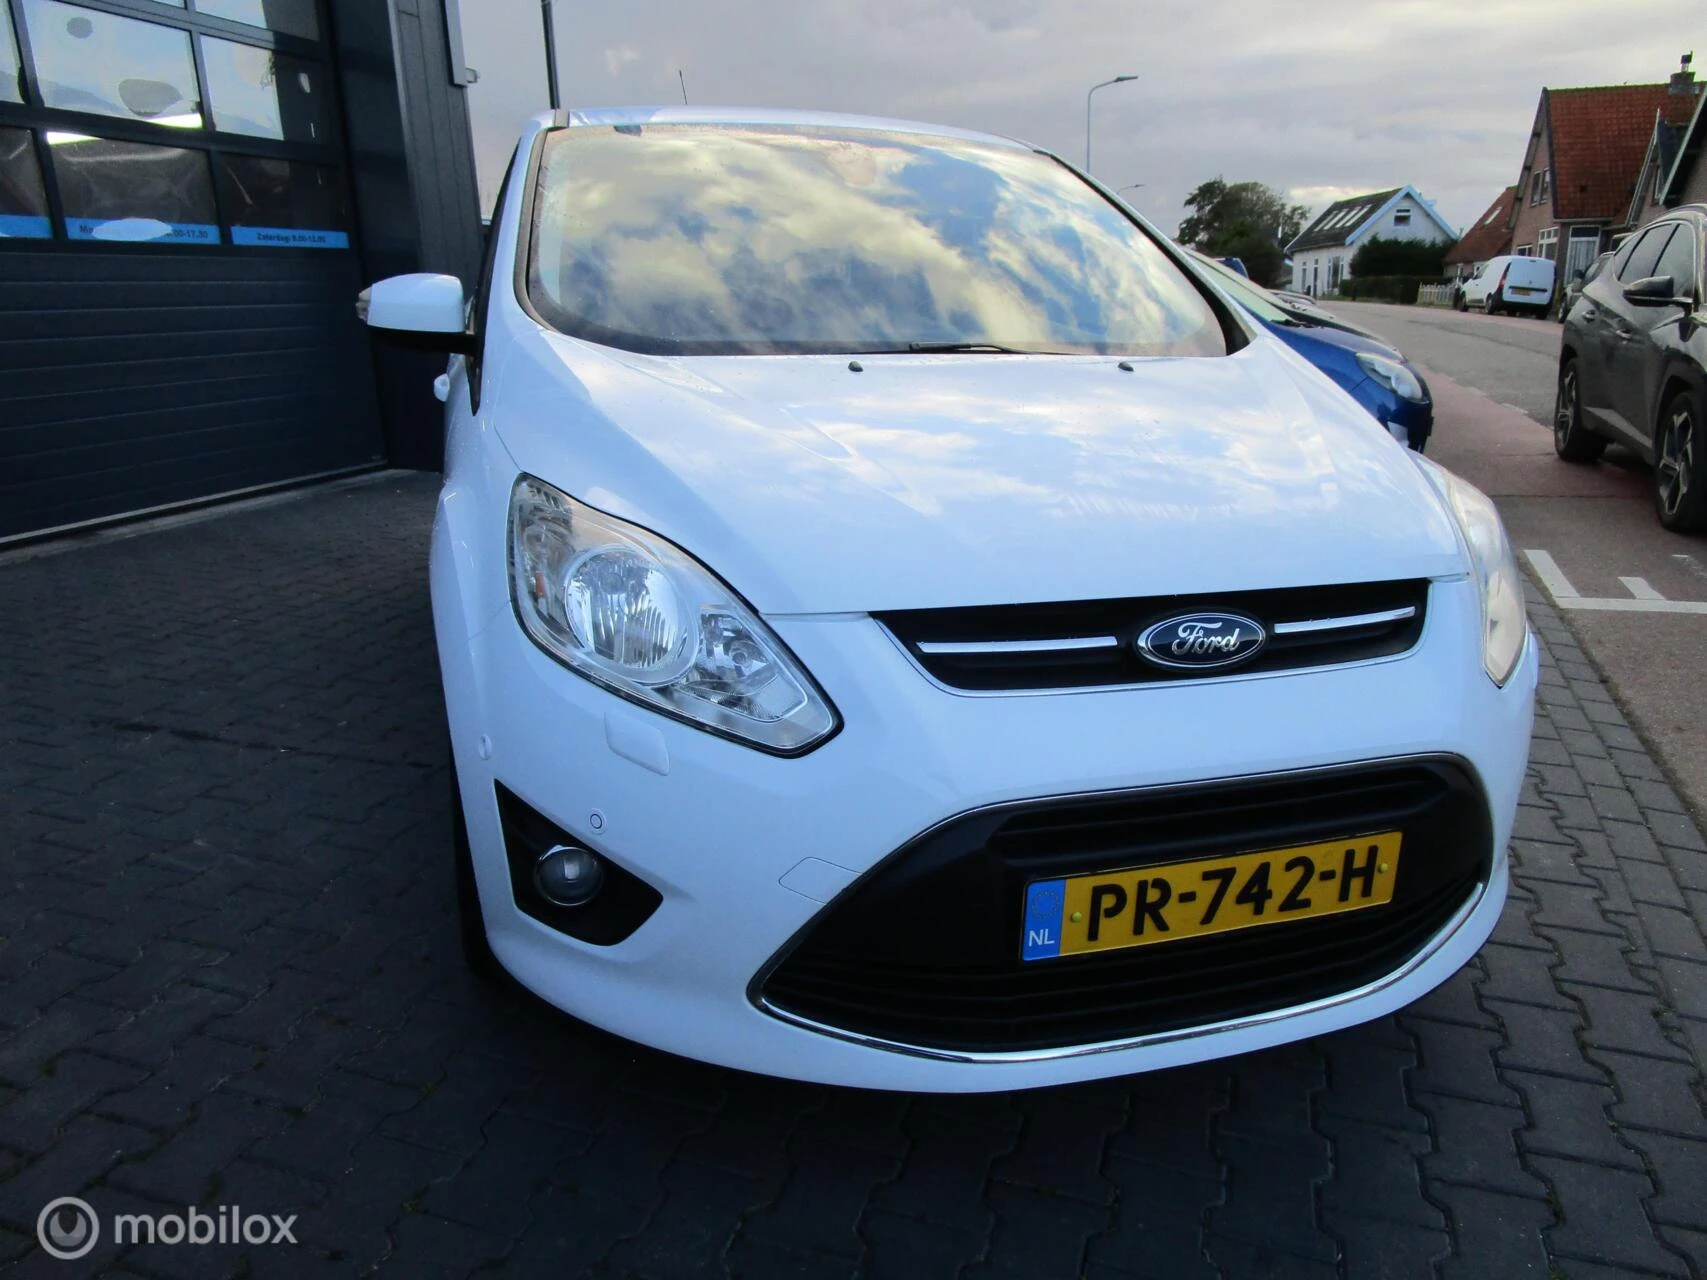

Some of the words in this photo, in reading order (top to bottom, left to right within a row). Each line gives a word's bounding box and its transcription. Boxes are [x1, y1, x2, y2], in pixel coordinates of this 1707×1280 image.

[1172, 621, 1240, 655] Ford
[1087, 845, 1379, 942] PR-742-H
[1028, 928, 1055, 947] NL
